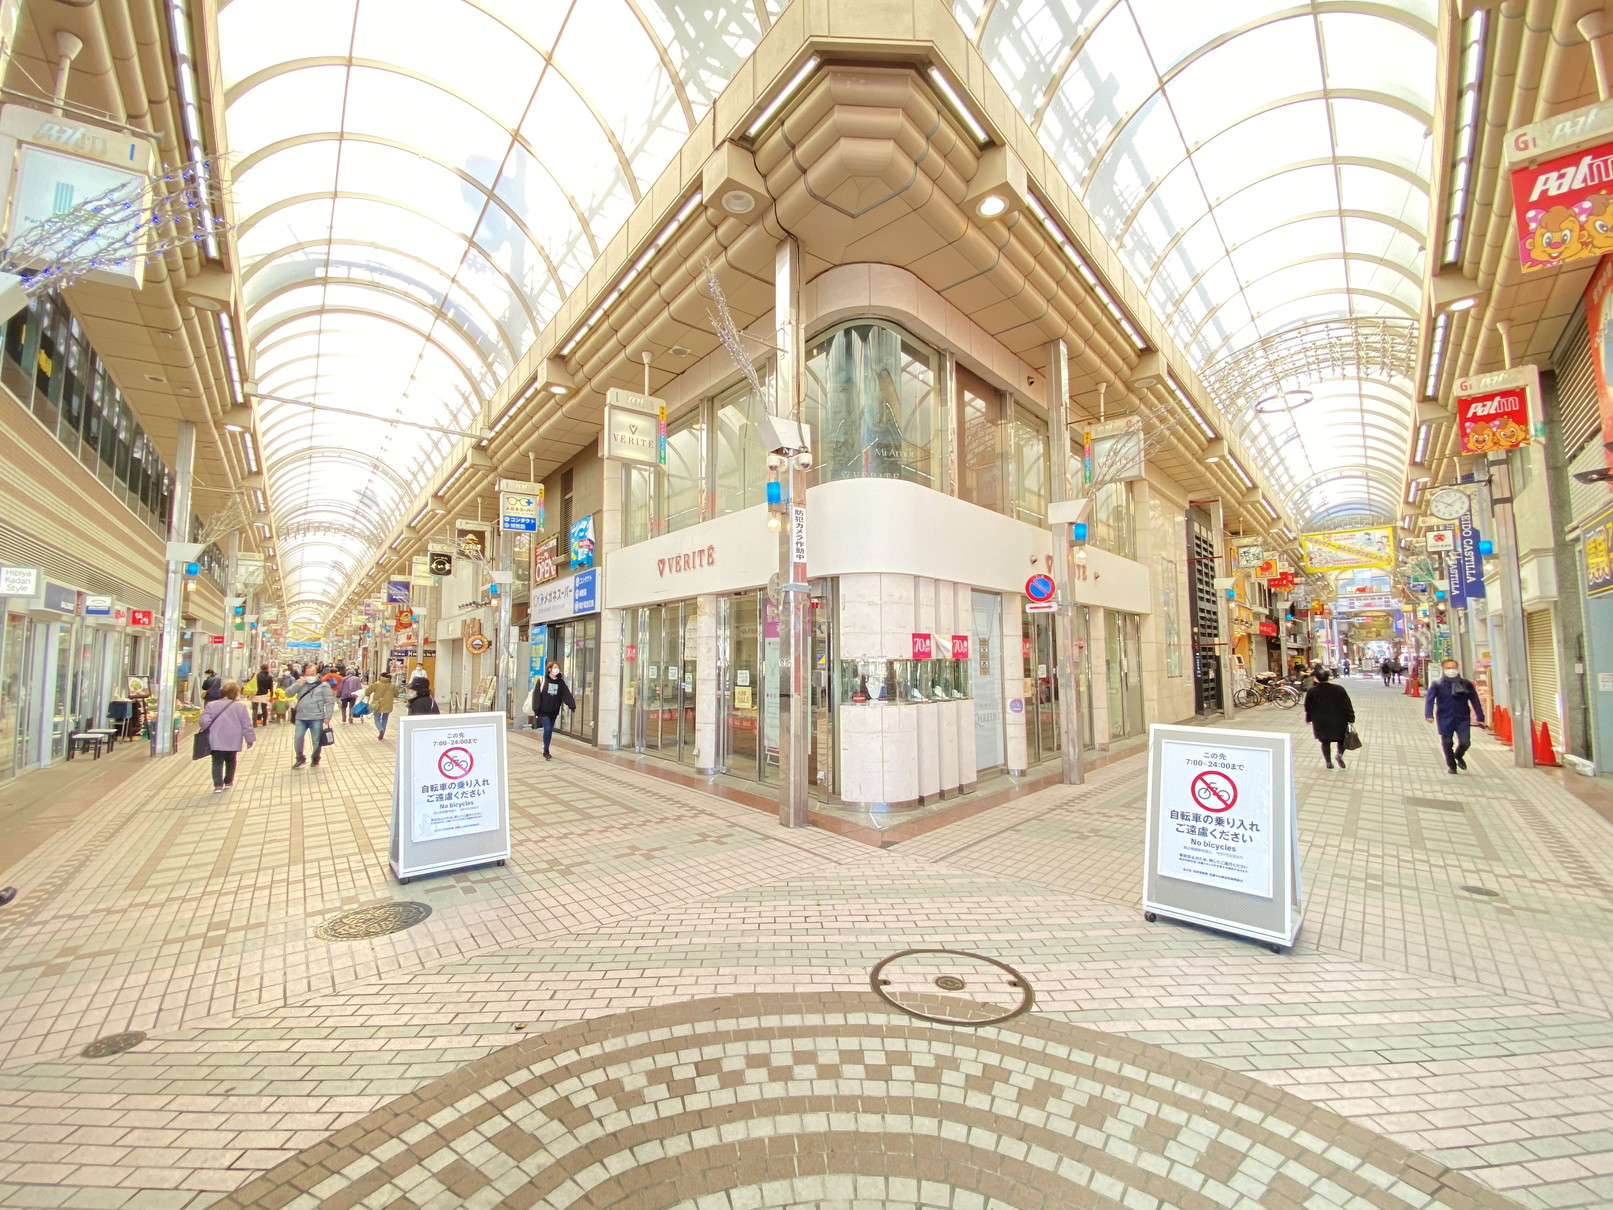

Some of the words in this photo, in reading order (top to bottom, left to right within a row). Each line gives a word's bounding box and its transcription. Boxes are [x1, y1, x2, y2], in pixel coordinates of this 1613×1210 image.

[613, 432, 654, 449] VERITE
[1461, 512, 1472, 537] EIDO
[794, 509, 805, 560] 防犯カメラ作動中
[1463, 538, 1477, 583] CASTILLA
[5, 569, 32, 578] Hibiya
[6, 584, 28, 592] Style
[544, 585, 573, 605] メガネスーパー
[1203, 752, 1227, 761] この先
[421, 778, 490, 794] 自転車の乗り入れ
[426, 789, 486, 803] ご遠慮ください
[1169, 809, 1261, 832] 自転車の乗り入れ
[1175, 822, 1253, 844] ご遠慮ください
[1190, 838, 1202, 846] No
[1203, 840, 1237, 852] bicycles
